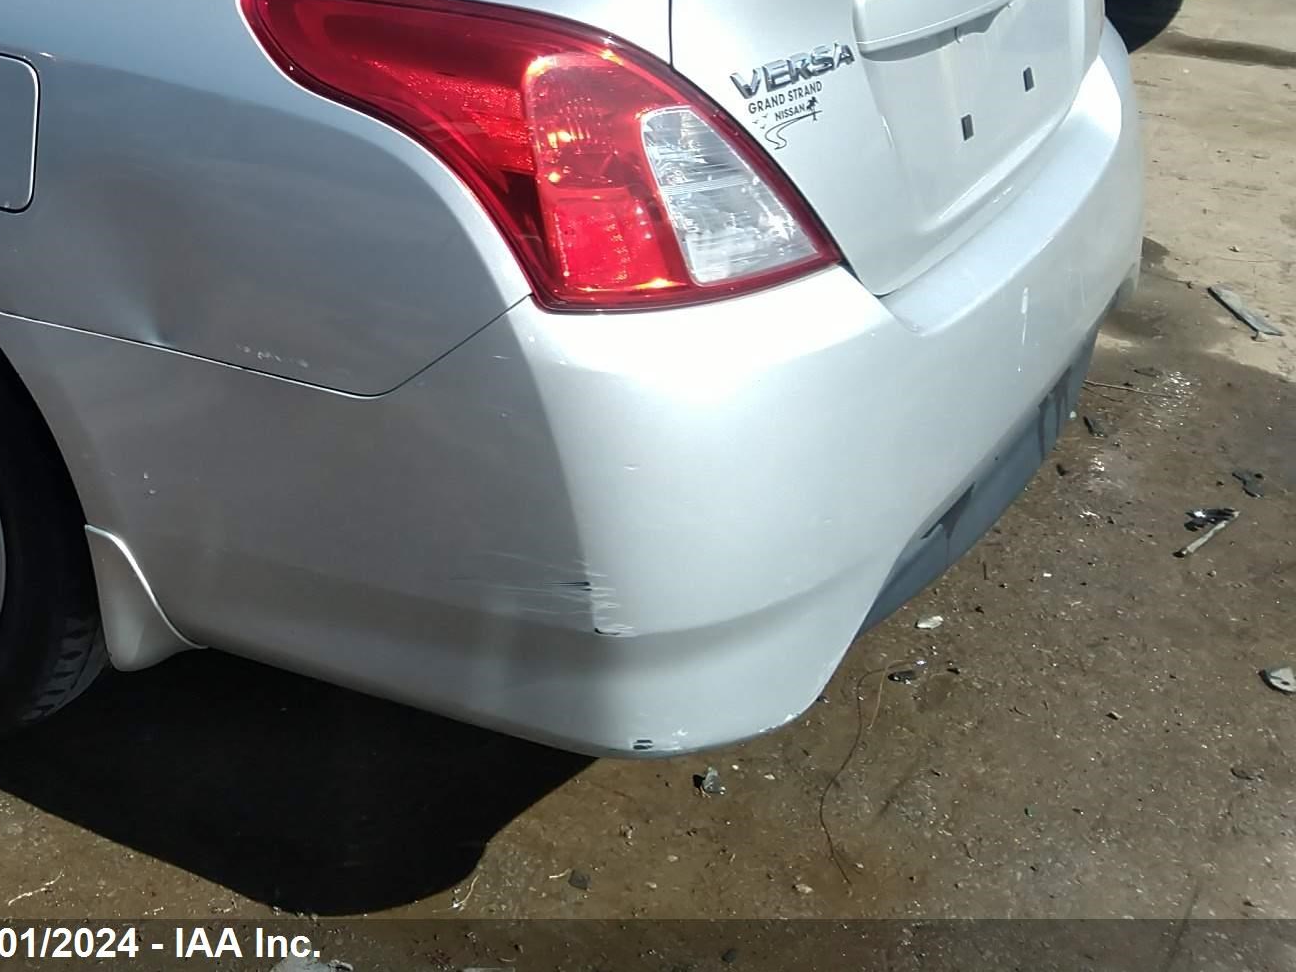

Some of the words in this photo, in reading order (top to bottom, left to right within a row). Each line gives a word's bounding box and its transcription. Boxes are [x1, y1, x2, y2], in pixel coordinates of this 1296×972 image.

[729, 40, 856, 99] VERSA
[747, 93, 786, 115] GRAND
[787, 80, 823, 102] STRAND
[774, 104, 806, 121] NISSAN
